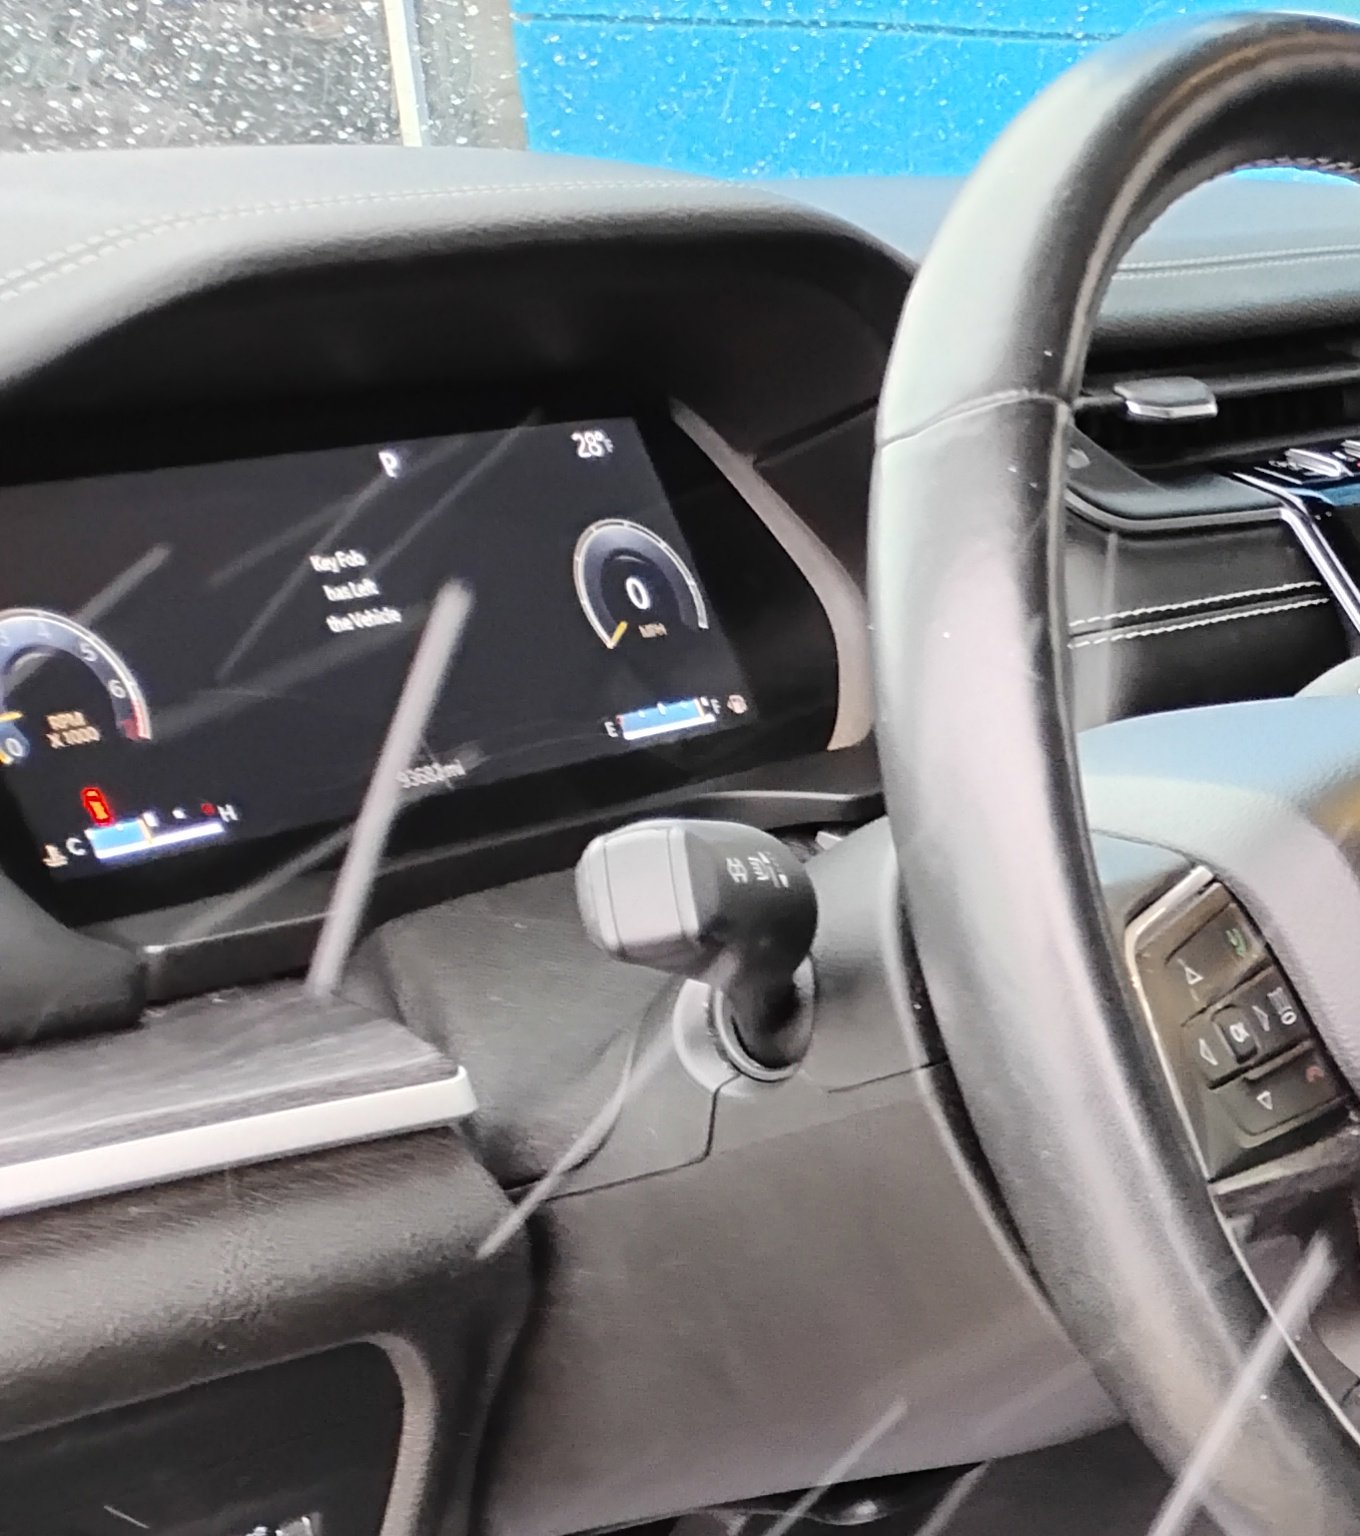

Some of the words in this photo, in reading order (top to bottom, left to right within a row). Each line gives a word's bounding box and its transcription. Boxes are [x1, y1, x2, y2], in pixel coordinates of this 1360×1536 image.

[379, 450, 397, 478] P
[625, 576, 650, 610] 0
[349, 607, 402, 628] Vehicle
[79, 641, 98, 662] 5
[107, 679, 126, 698] 6
[710, 698, 721, 714] F
[604, 721, 618, 738] E
[217, 804, 241, 823] H
[66, 837, 86, 856] C
